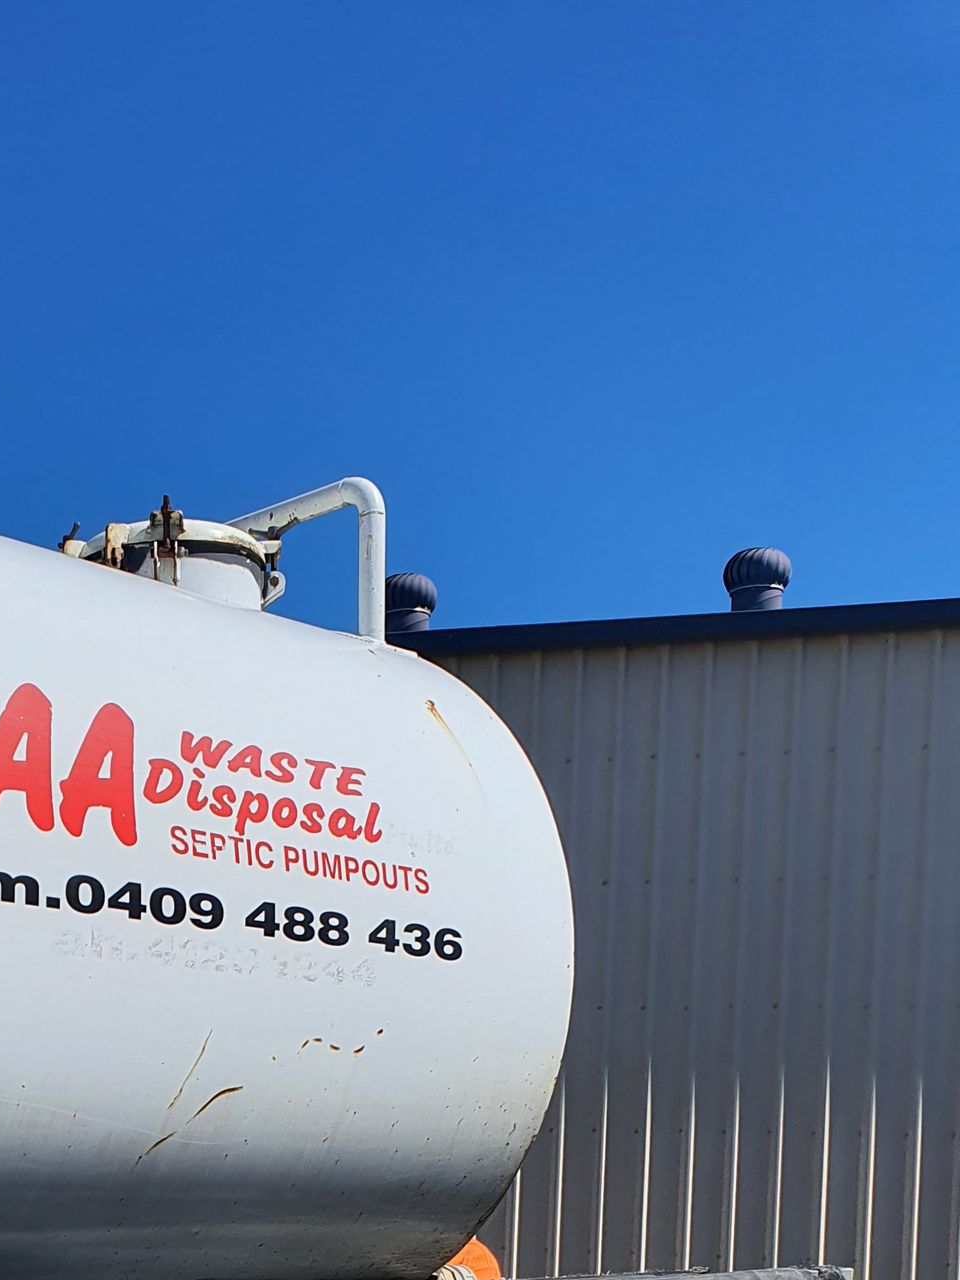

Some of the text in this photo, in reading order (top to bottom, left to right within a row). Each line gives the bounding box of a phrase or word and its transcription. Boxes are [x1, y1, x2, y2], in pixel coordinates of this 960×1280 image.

[180, 731, 365, 797] WASTE
[143, 759, 383, 844] Disposal
[170, 826, 430, 895] SEPTIC PUMPOUTS
[245, 902, 350, 947] 488
[369, 919, 463, 961] 436
